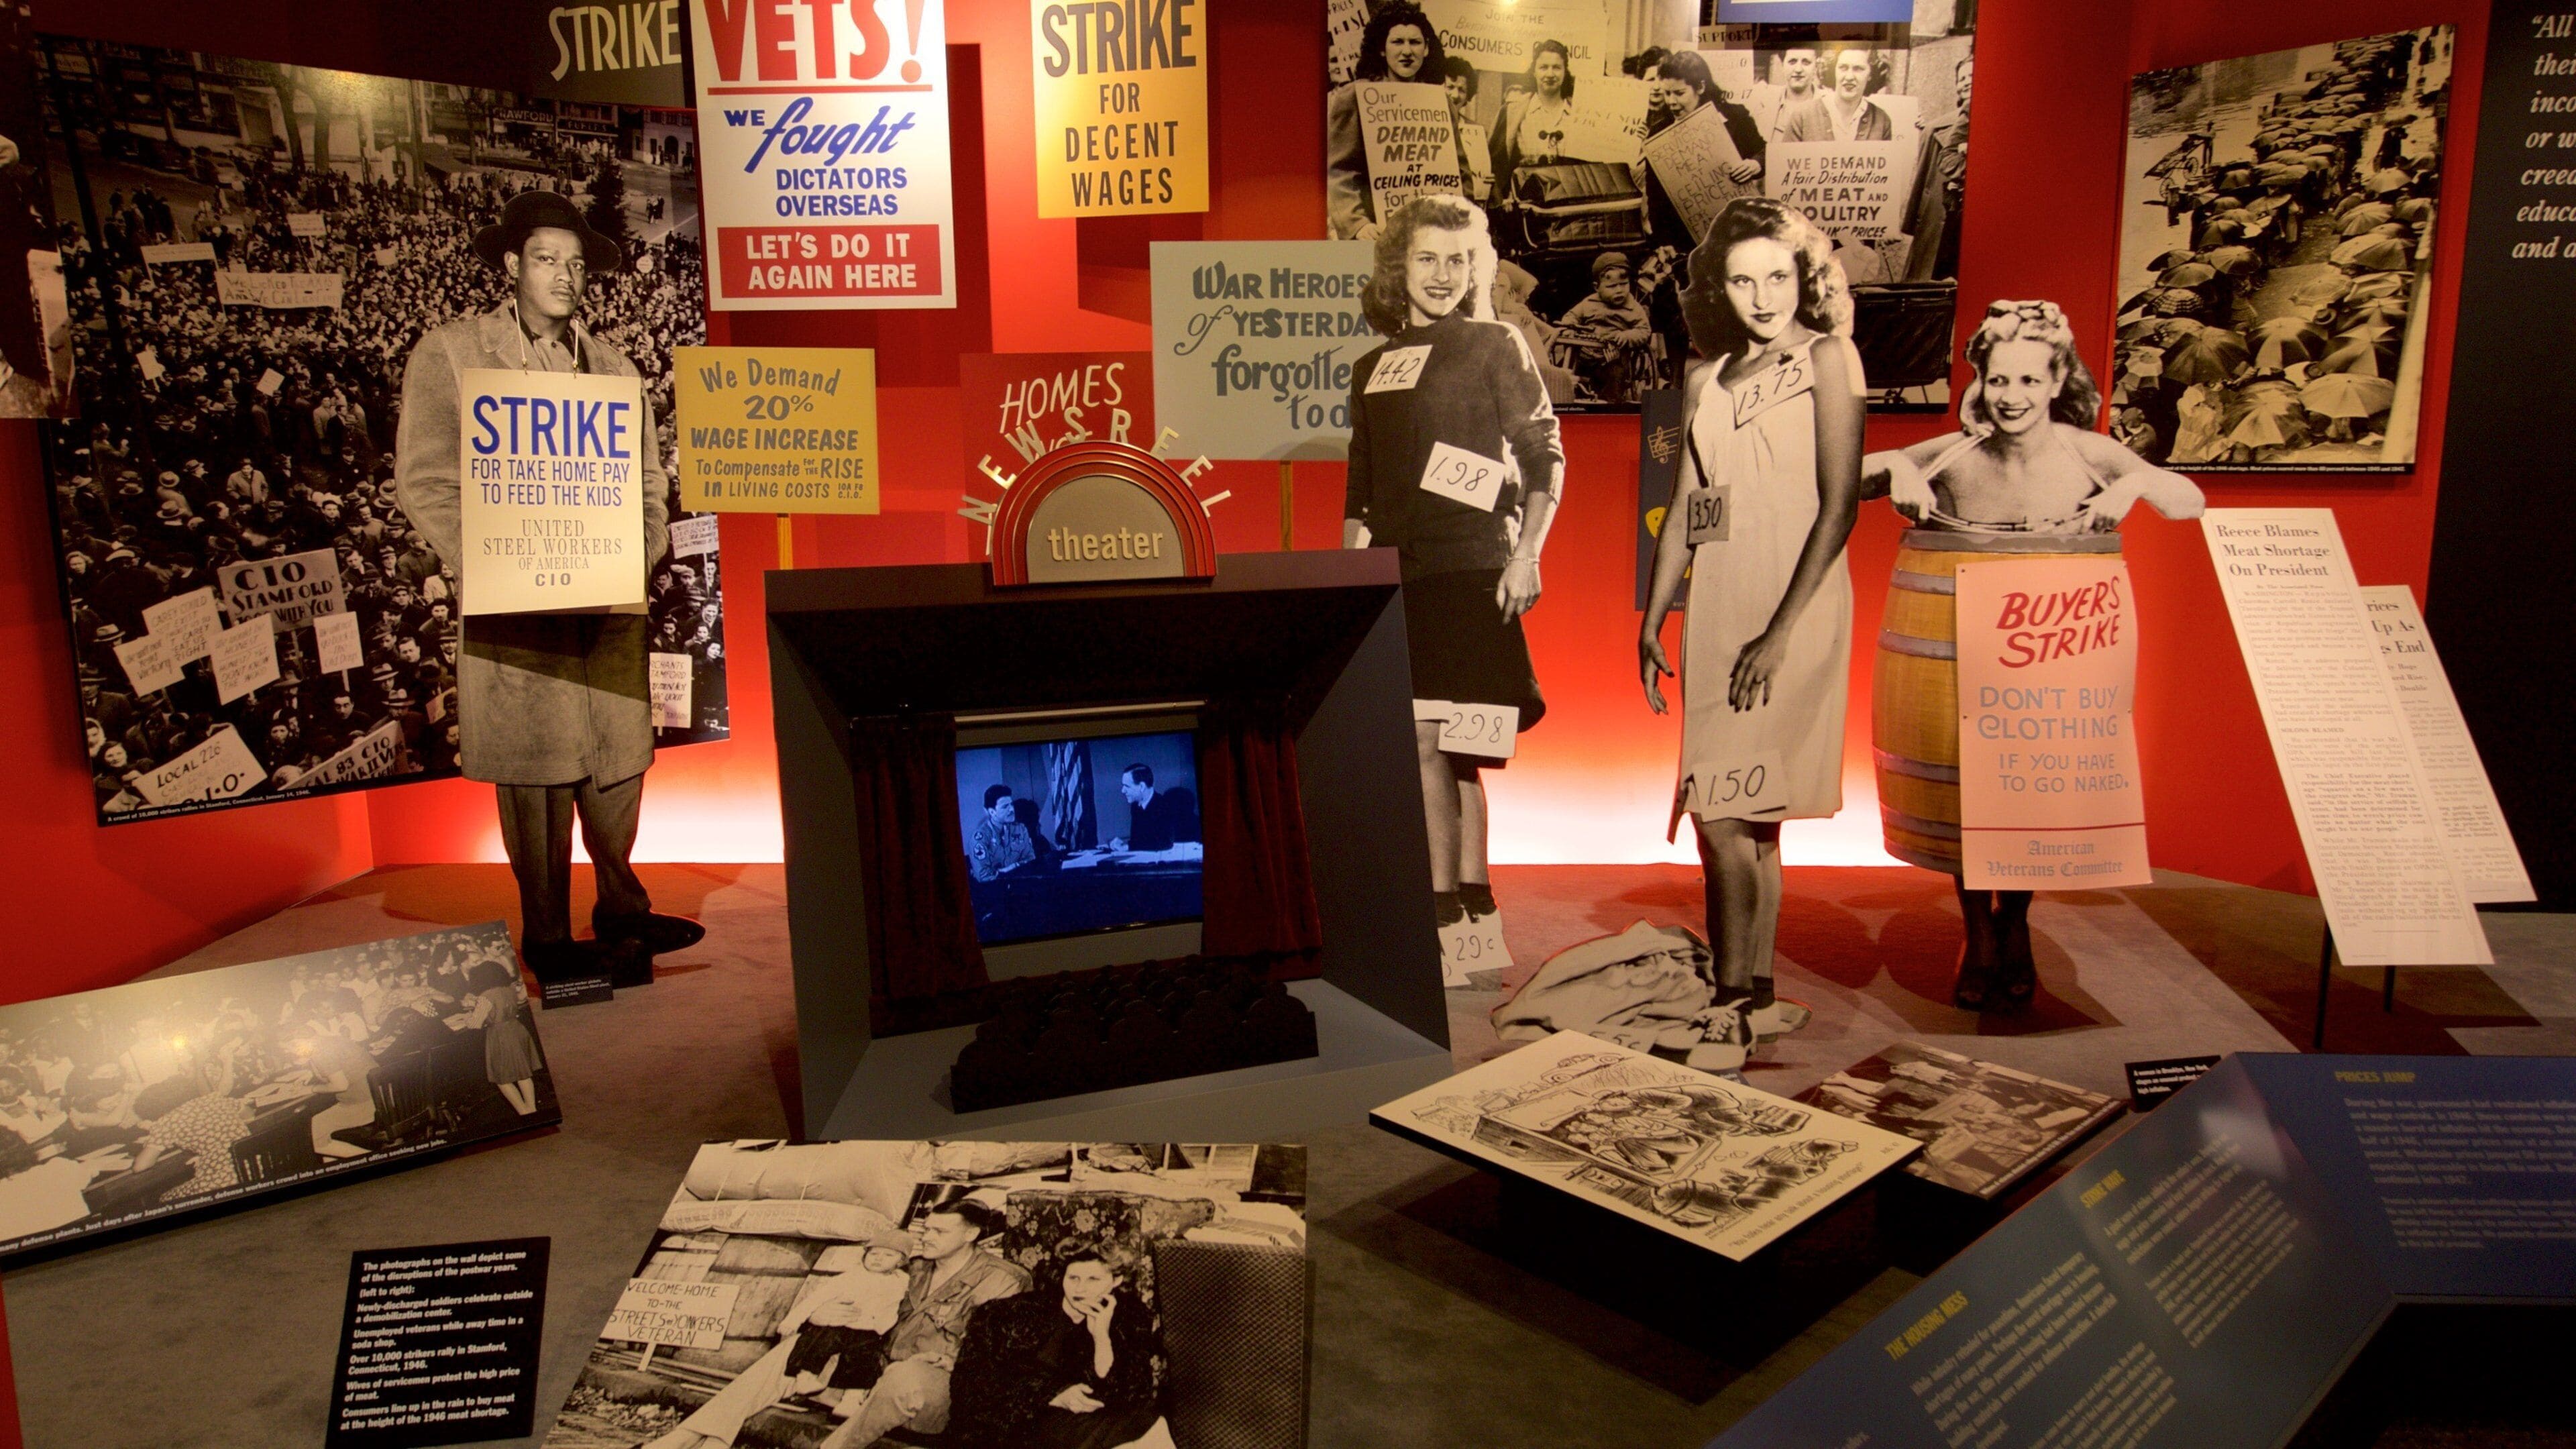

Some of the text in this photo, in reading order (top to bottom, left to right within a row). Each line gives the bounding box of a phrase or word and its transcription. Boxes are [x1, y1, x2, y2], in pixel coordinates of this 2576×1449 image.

[1485, 9, 1544, 25] JOIN THE
[549, 1, 682, 82] STRIKE
[705, 0, 925, 84] VETS!
[1042, 0, 1196, 78] STRIKE
[1439, 30, 1523, 56] CONSUMERS
[1697, 29, 1752, 43] SUPPORT
[2534, 52, 2576, 76] thei
[1100, 83, 1140, 114] FOR
[1364, 87, 1397, 105] Our
[2530, 90, 2576, 113] inco
[1366, 104, 1448, 123] Servicemen
[724, 97, 916, 173] WE fought
[1065, 121, 1178, 162] DECENT
[1377, 126, 1450, 144] DEMAND
[2525, 131, 2553, 148] or
[1383, 144, 1442, 162] MEAT
[1787, 156, 1886, 170] WE DEMAND
[776, 168, 907, 190] DICTATORS
[1407, 164, 1424, 172] AT
[1781, 170, 1888, 186] A Fair Distribution
[1071, 167, 1173, 207] WAGES
[1374, 174, 1460, 190] CEILING PRICES
[776, 194, 898, 217] OVERSEAS
[1384, 191, 1408, 208] for
[1780, 188, 1888, 203] of MEAT AND
[1794, 206, 1881, 221] OULTRY
[1851, 226, 1888, 238] PRICES
[746, 231, 910, 260] LET'S DO IT
[2512, 235, 2561, 258] and
[748, 264, 917, 290] AGAIN HERE
[1193, 260, 1372, 300] WAR HEROES
[1174, 305, 1380, 356] of YESTERDA
[699, 358, 841, 396] We Demand
[1212, 343, 1352, 402] forgotte
[743, 394, 814, 421] 20%
[1000, 362, 1124, 434] HOMES
[1287, 394, 1352, 430] tod
[472, 394, 630, 459] STRIKE
[690, 427, 859, 451] WAGE INCREASE
[472, 458, 629, 483] FOR TAKE HOME PAY
[696, 459, 712, 476] To
[714, 459, 800, 481] Compensate
[820, 458, 863, 479] RISE
[1430, 457, 1489, 491] 1.98
[481, 483, 622, 506] TO FEED THE KIDS
[729, 482, 778, 498] LIVING
[786, 483, 830, 498] COSTS
[522, 519, 584, 537] UNITED
[2216, 525, 2319, 537] Reece Blames
[484, 538, 622, 555] STEEL WORKERS
[1048, 527, 1163, 561] theater
[2222, 544, 2330, 558] Meat Shortage
[519, 557, 589, 570] OF AMERICA
[2229, 563, 2329, 576] On President
[535, 573, 571, 586] CIO
[232, 580, 333, 615] STAMFORD
[1996, 576, 2120, 631] BUYERS
[2367, 600, 2400, 611] rices
[274, 598, 334, 622] WITH YOU
[2371, 619, 2414, 636] Up As
[1998, 614, 2120, 668] STRIKE
[2394, 639, 2425, 653] End
[1980, 686, 2118, 710] DON'T BUY
[1444, 712, 1503, 743] 2.98
[1978, 714, 2117, 741] CLOTHING
[1999, 753, 2115, 771] IF YOU HAVE
[157, 760, 199, 788] LOCAL
[1708, 765, 1765, 806] 1.50
[1999, 773, 2129, 793] TO GO NAKED.
[2027, 840, 2094, 856] American
[1988, 861, 2123, 877] Veterans Committee
[21, 1195, 213, 1247] defense plants. Just days after Japan's surrender,
[363, 1251, 527, 1271] The photographs on the wall depict some
[610, 1309, 666, 1327] STREETS
[628, 1327, 698, 1346] VETERAN
[342, 1393, 515, 1417] Consumers line up in the rain to buy meat
